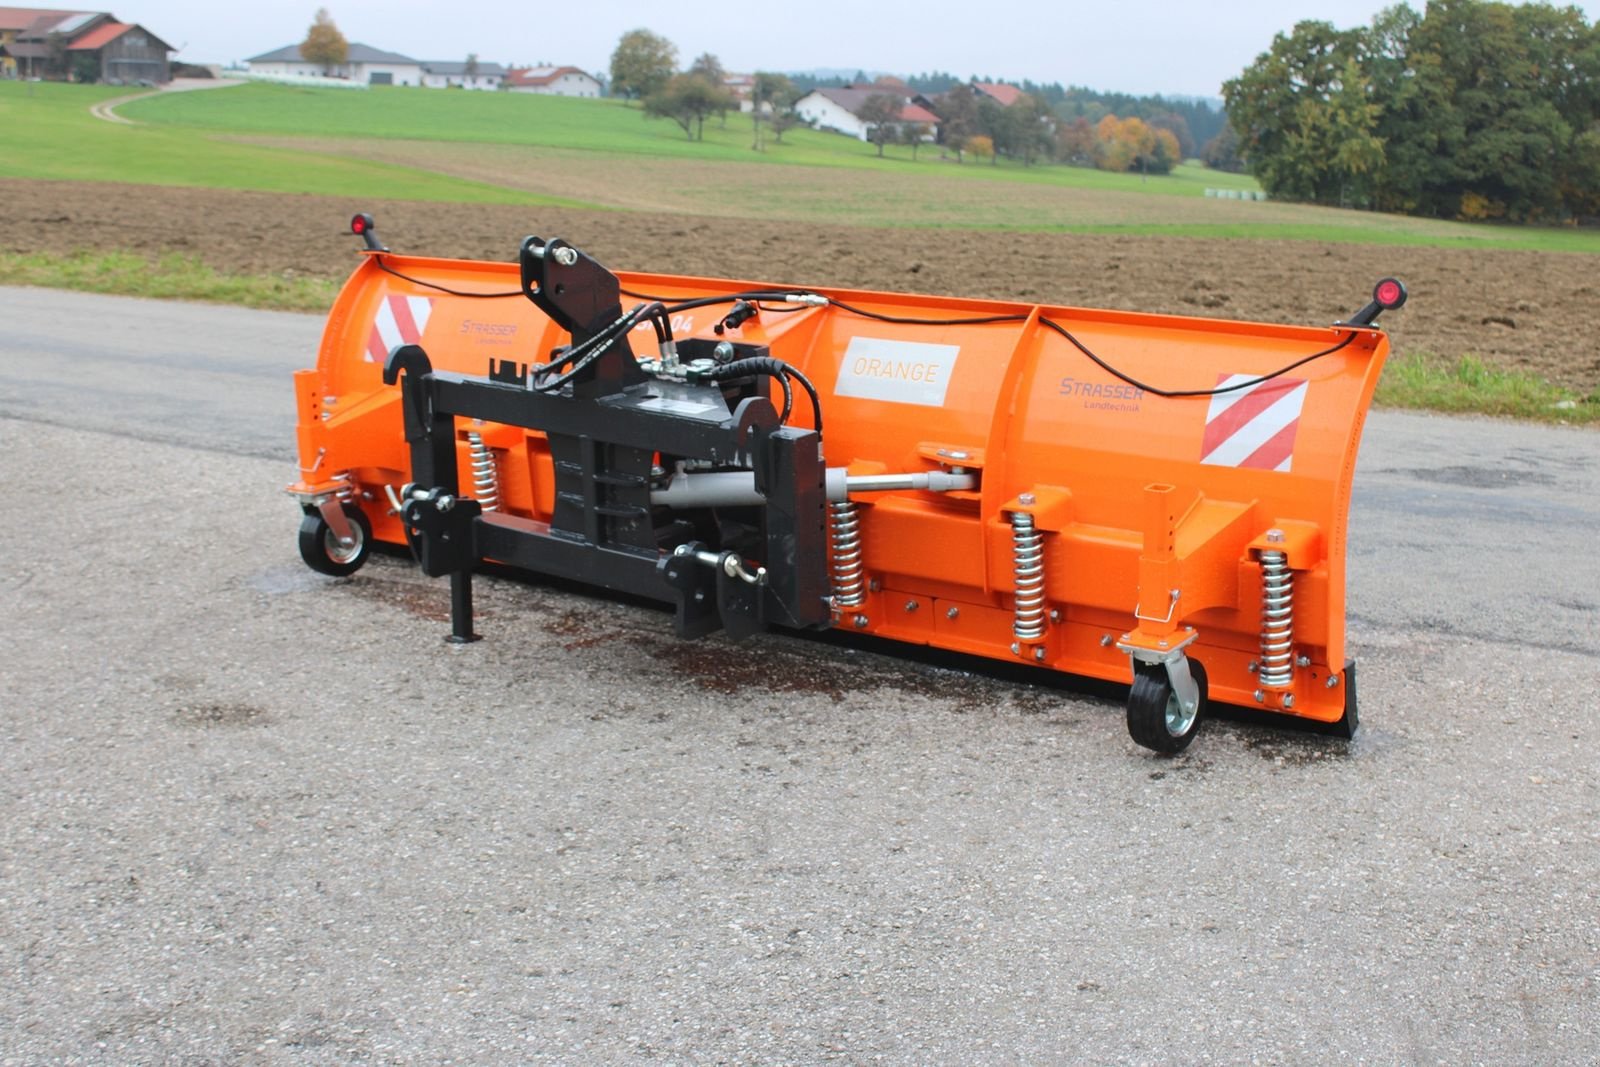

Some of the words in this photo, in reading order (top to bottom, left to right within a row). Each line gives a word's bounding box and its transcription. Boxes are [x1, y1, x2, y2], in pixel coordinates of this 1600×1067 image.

[853, 357, 940, 383] ORANGE
[1060, 377, 1144, 400] STRASSER
[1084, 400, 1140, 412] Landtechnik
